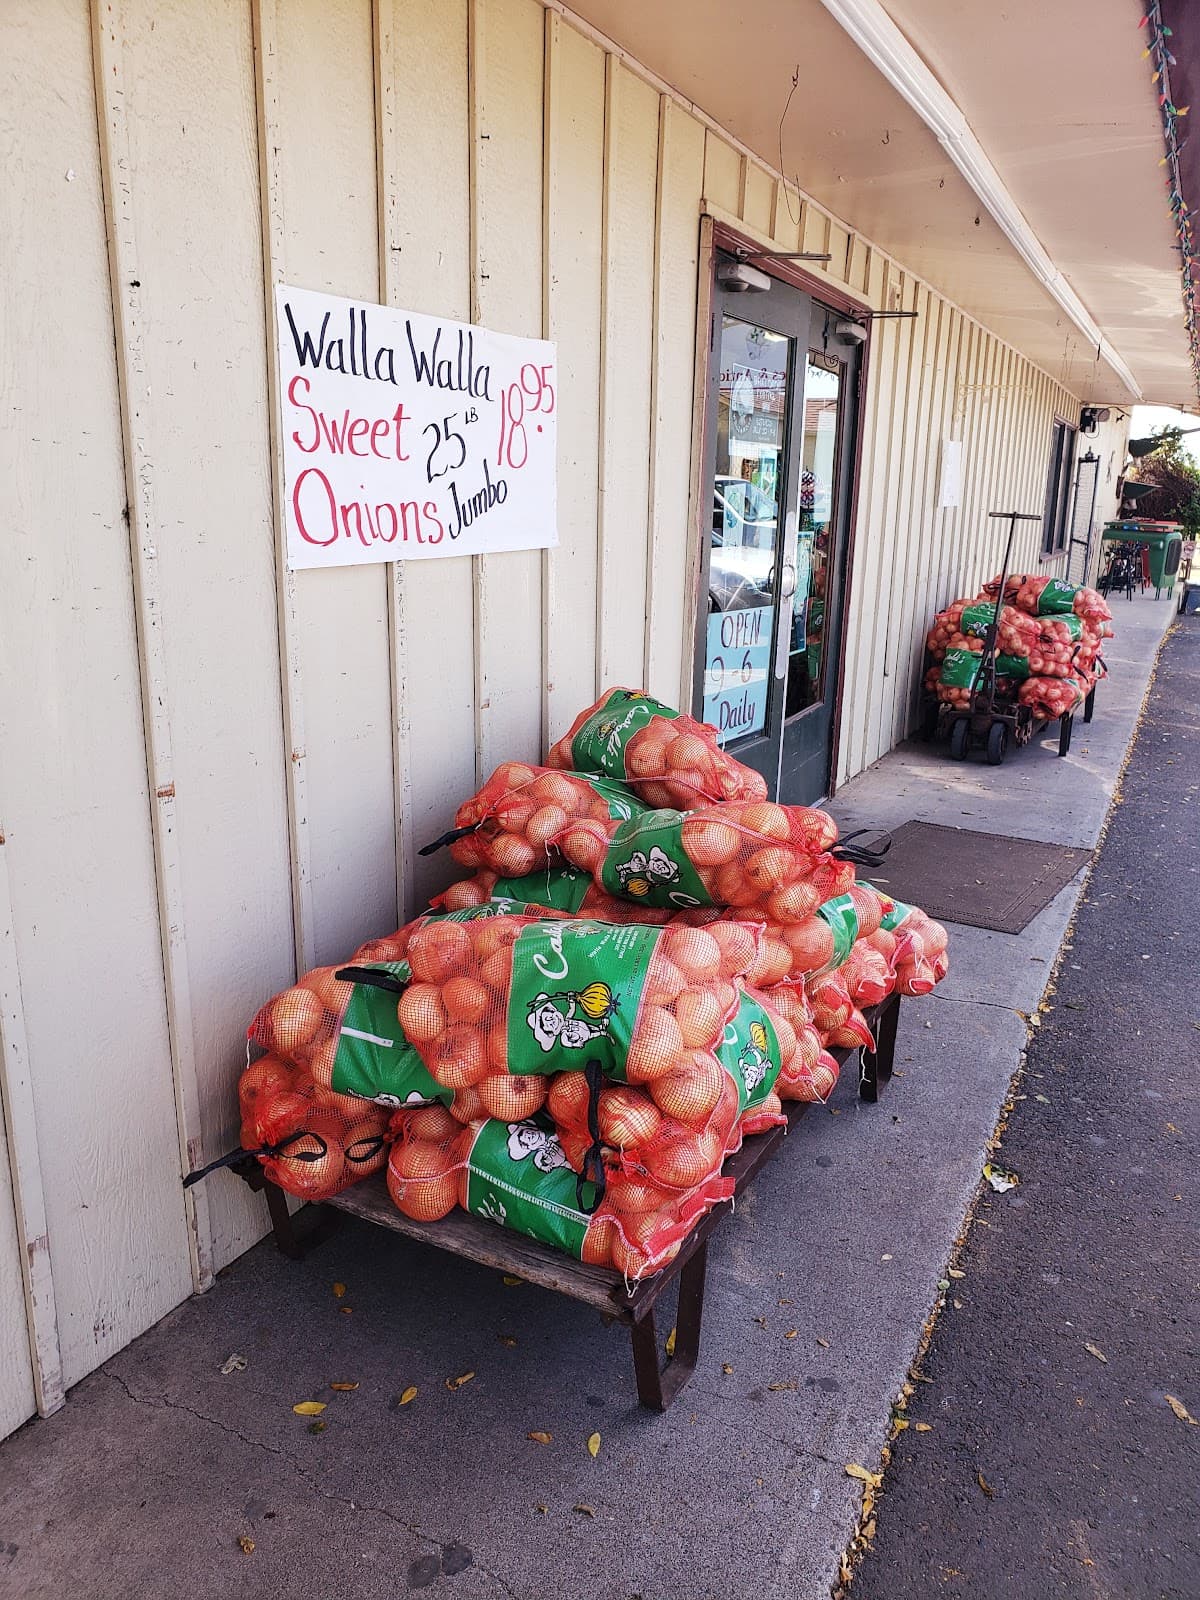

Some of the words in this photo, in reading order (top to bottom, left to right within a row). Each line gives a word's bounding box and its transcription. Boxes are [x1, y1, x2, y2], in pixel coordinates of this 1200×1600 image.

[284, 303, 399, 385] Walla
[405, 320, 494, 401] Walla
[288, 375, 411, 460] Sweet
[422, 413, 467, 483] 25
[465, 407, 479, 424] LB
[292, 468, 444, 546] Onions
[449, 458, 508, 539] Jumbo
[720, 609, 762, 649] OPEN
[719, 690, 756, 733] Daily
